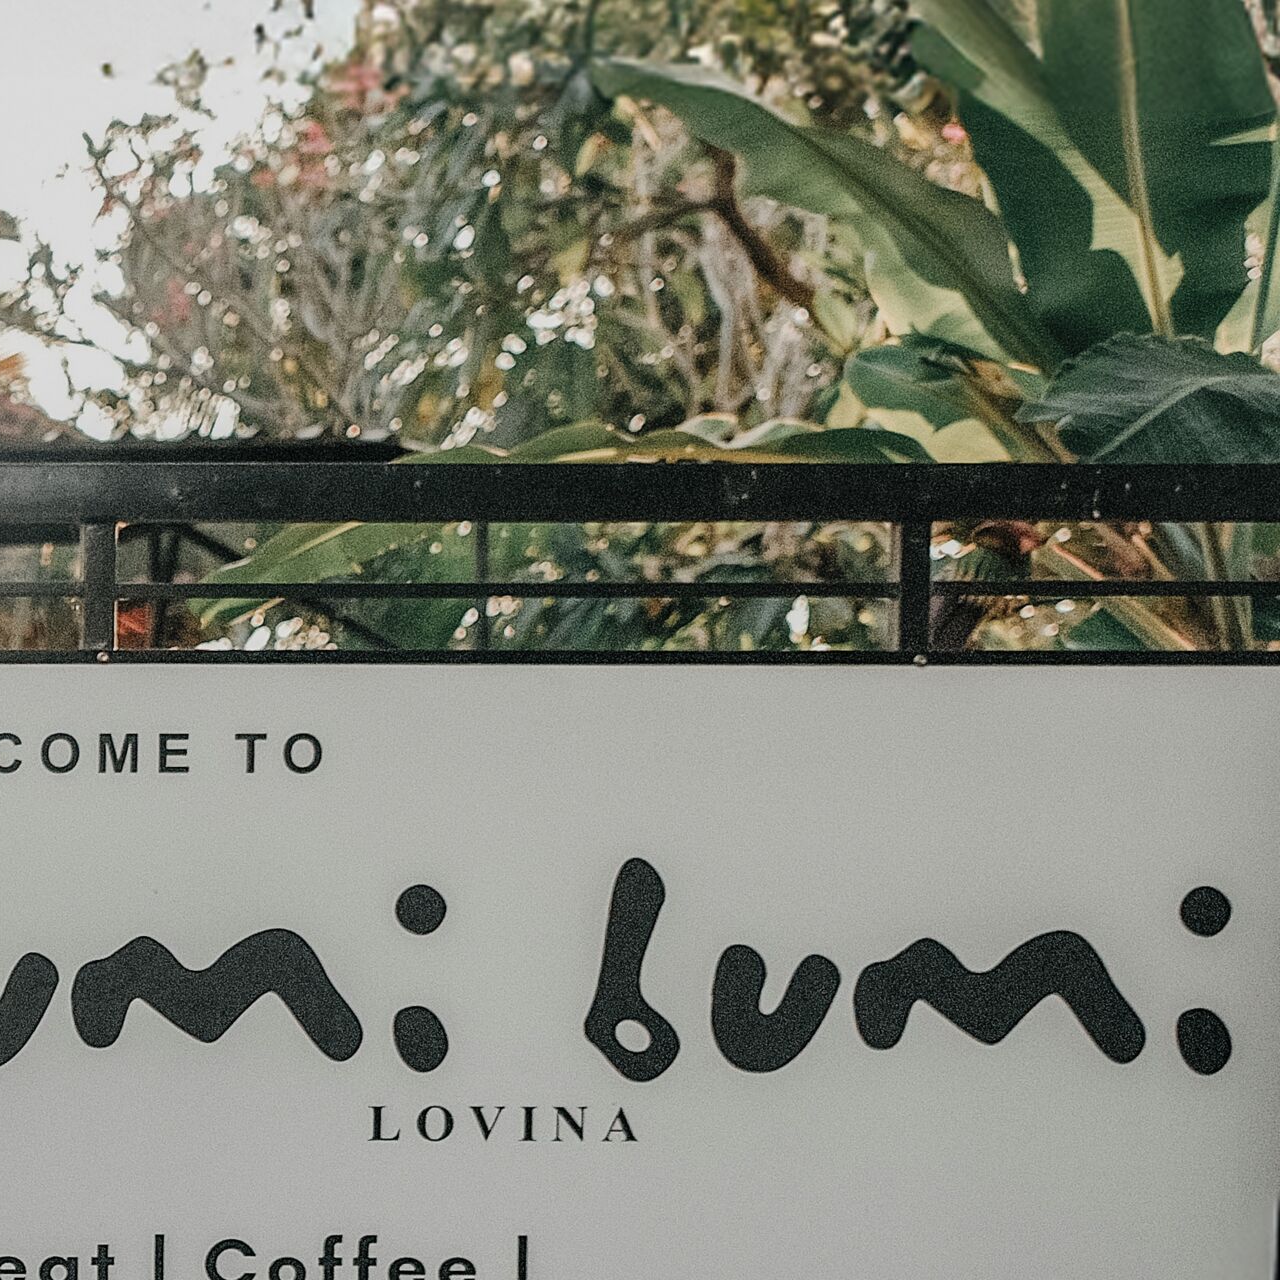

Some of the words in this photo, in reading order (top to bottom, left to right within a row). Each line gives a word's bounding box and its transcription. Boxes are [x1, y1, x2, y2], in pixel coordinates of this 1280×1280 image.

[235, 732, 323, 774] TO
[583, 857, 1234, 1083] bumi
[370, 1105, 637, 1142] LOVINA
